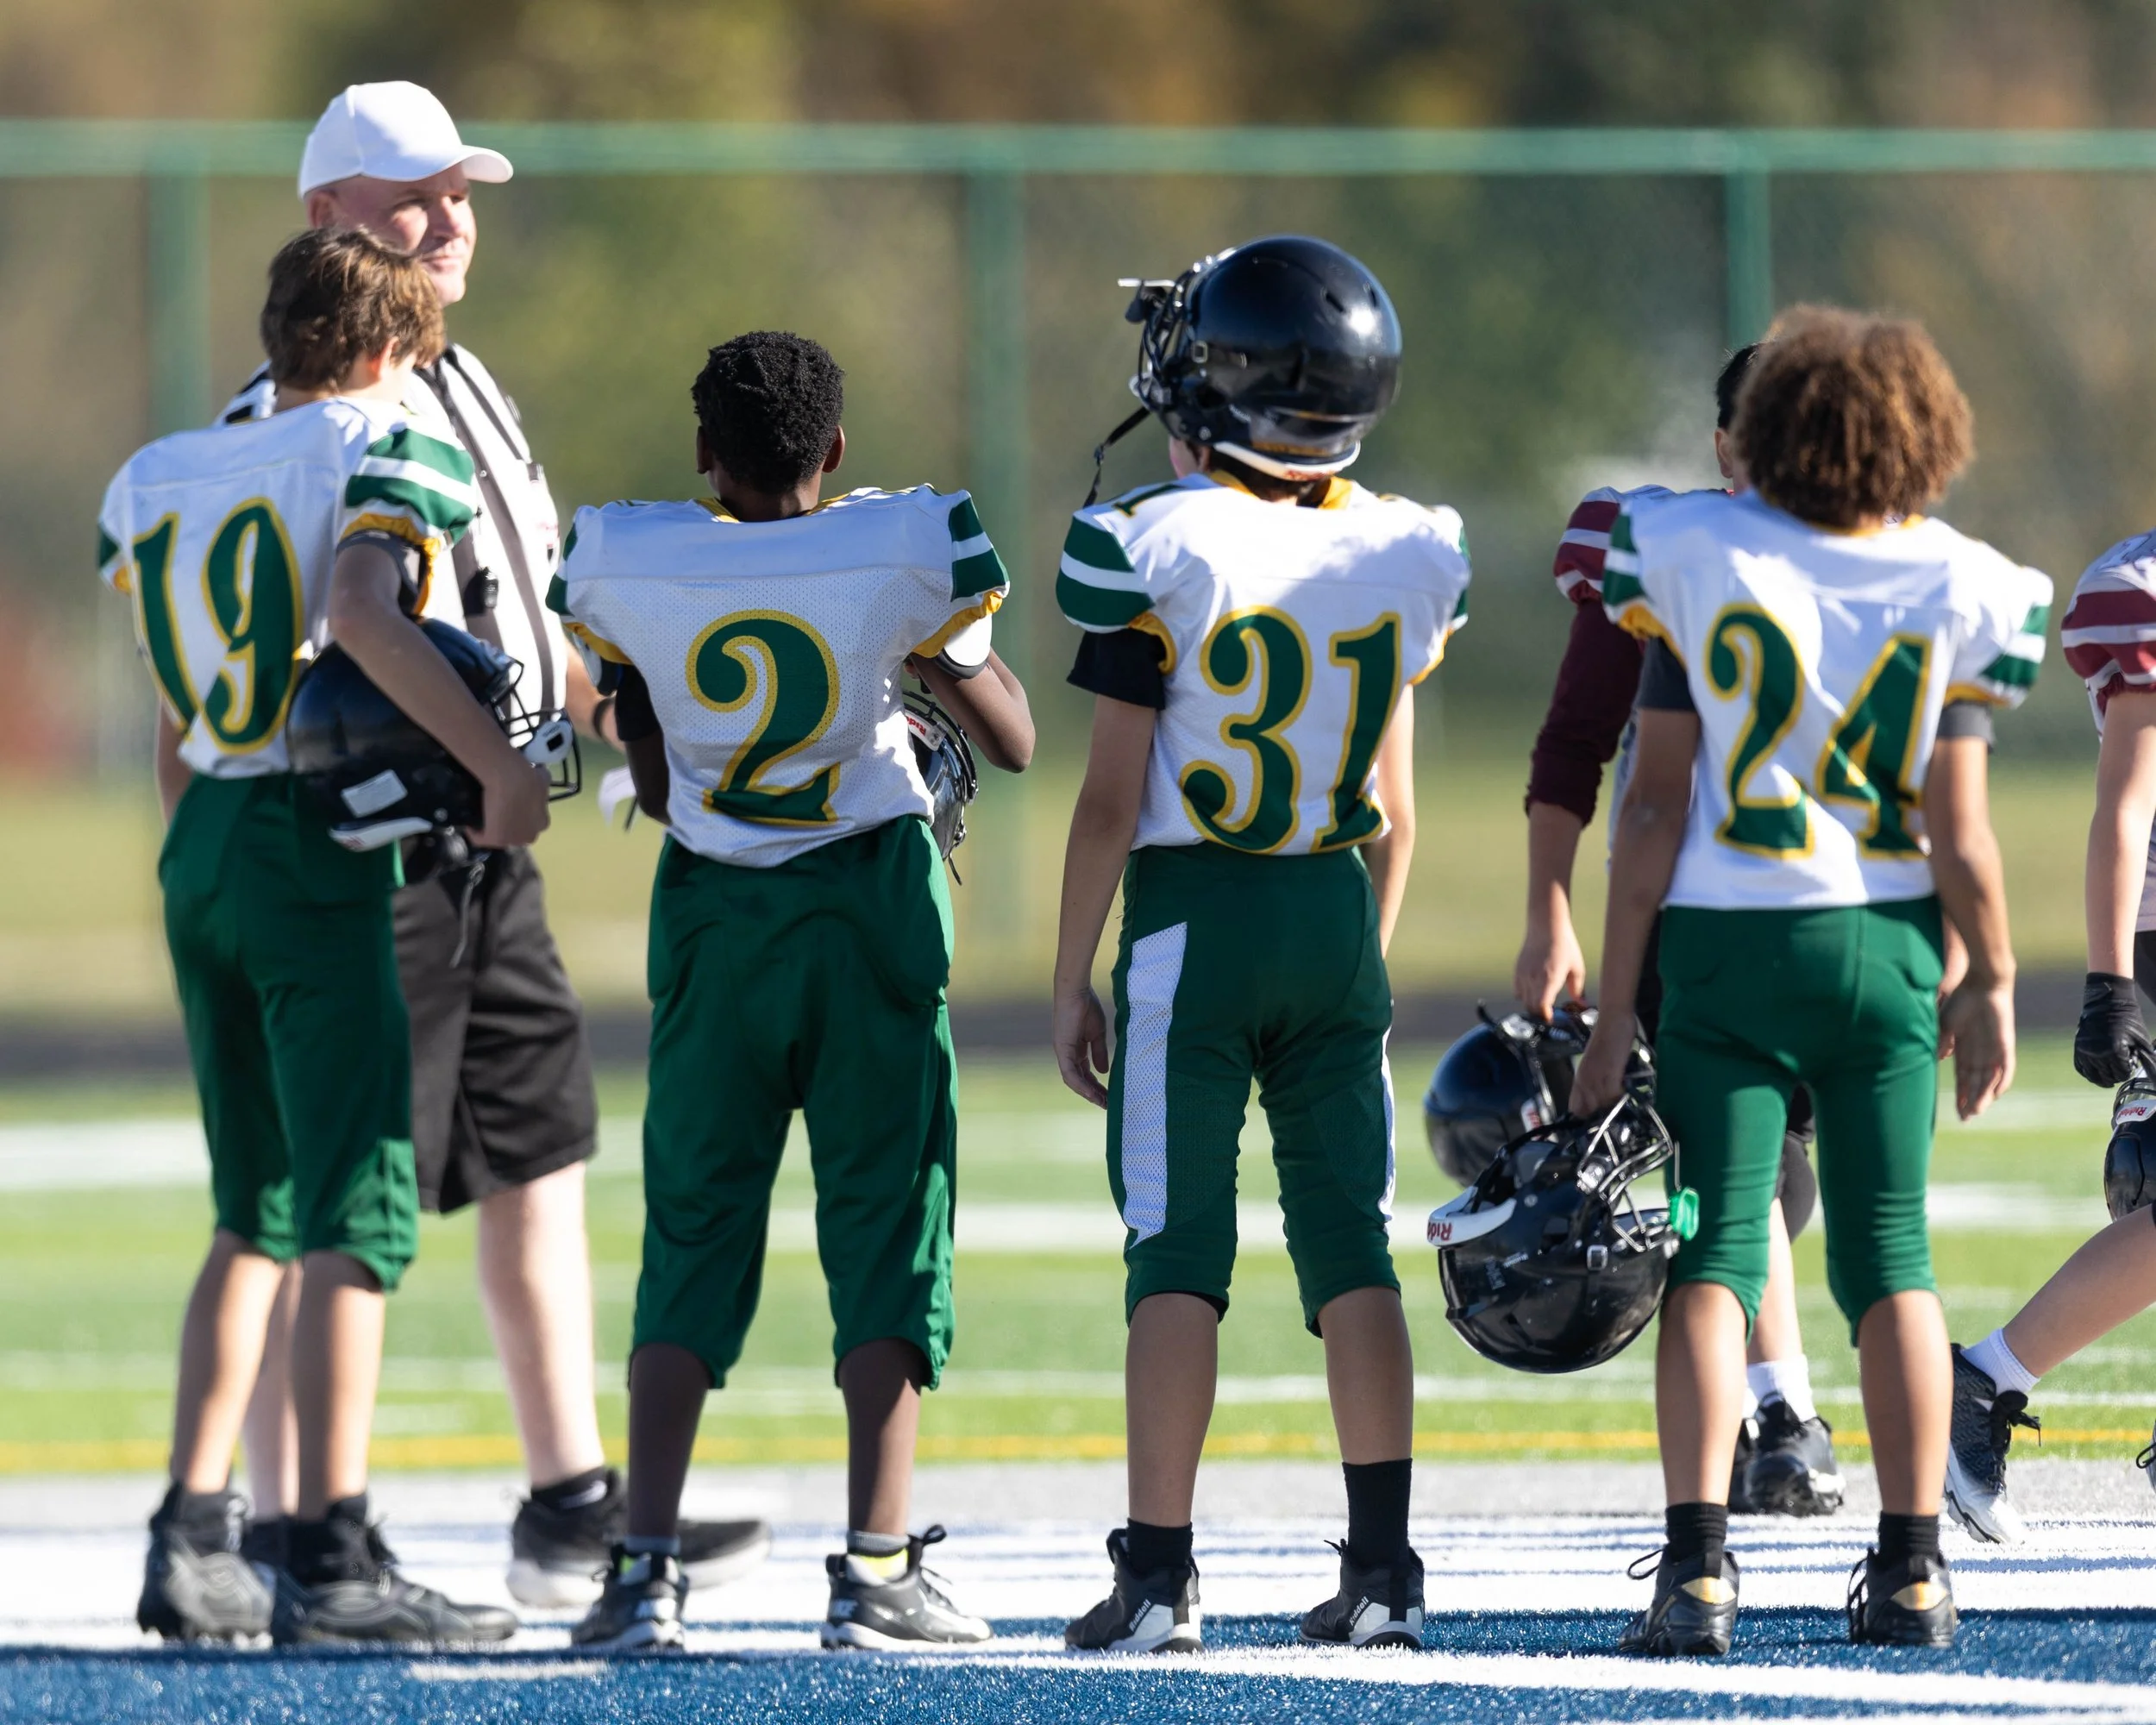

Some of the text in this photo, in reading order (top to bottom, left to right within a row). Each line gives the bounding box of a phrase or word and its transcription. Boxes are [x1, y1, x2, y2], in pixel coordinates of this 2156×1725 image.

[131, 497, 304, 756] 19
[686, 609, 840, 827] 2
[1179, 605, 1402, 855] 31
[1704, 603, 1932, 861] 24
[1349, 1596, 1369, 1627] Riddell
